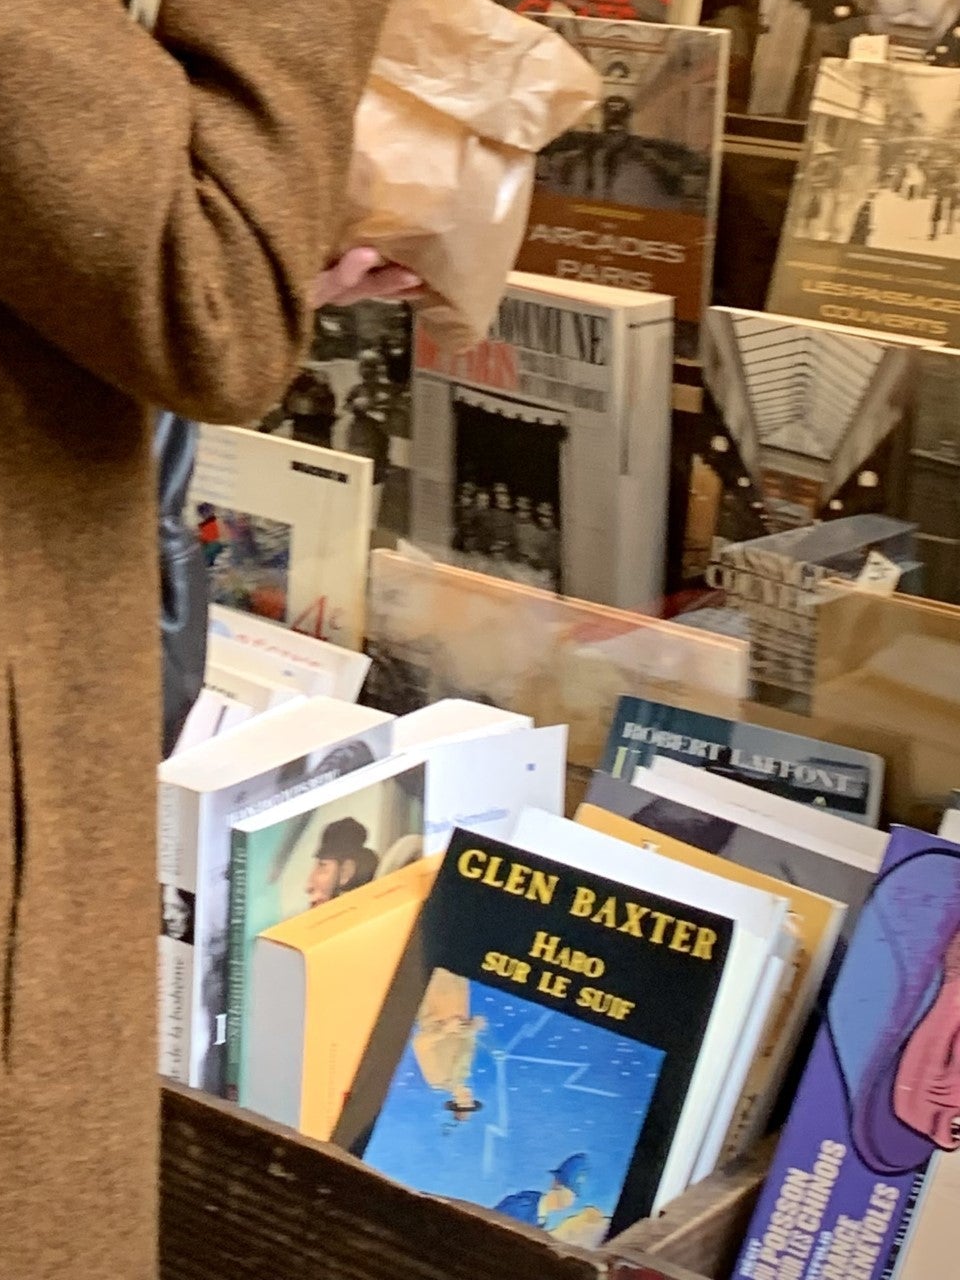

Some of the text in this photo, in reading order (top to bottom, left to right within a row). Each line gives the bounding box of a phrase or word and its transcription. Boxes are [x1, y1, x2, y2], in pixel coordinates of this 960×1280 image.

[528, 224, 687, 263] ARCADES
[556, 258, 654, 290] PARIS
[623, 722, 855, 793] ROBERT LAFFONT
[457, 848, 718, 961] GLEN BAXTER
[537, 971, 572, 999] LE
[575, 986, 636, 1021] SUIF
[759, 1167, 809, 1265] POISSON
[795, 1139, 847, 1233] CHINOIS
